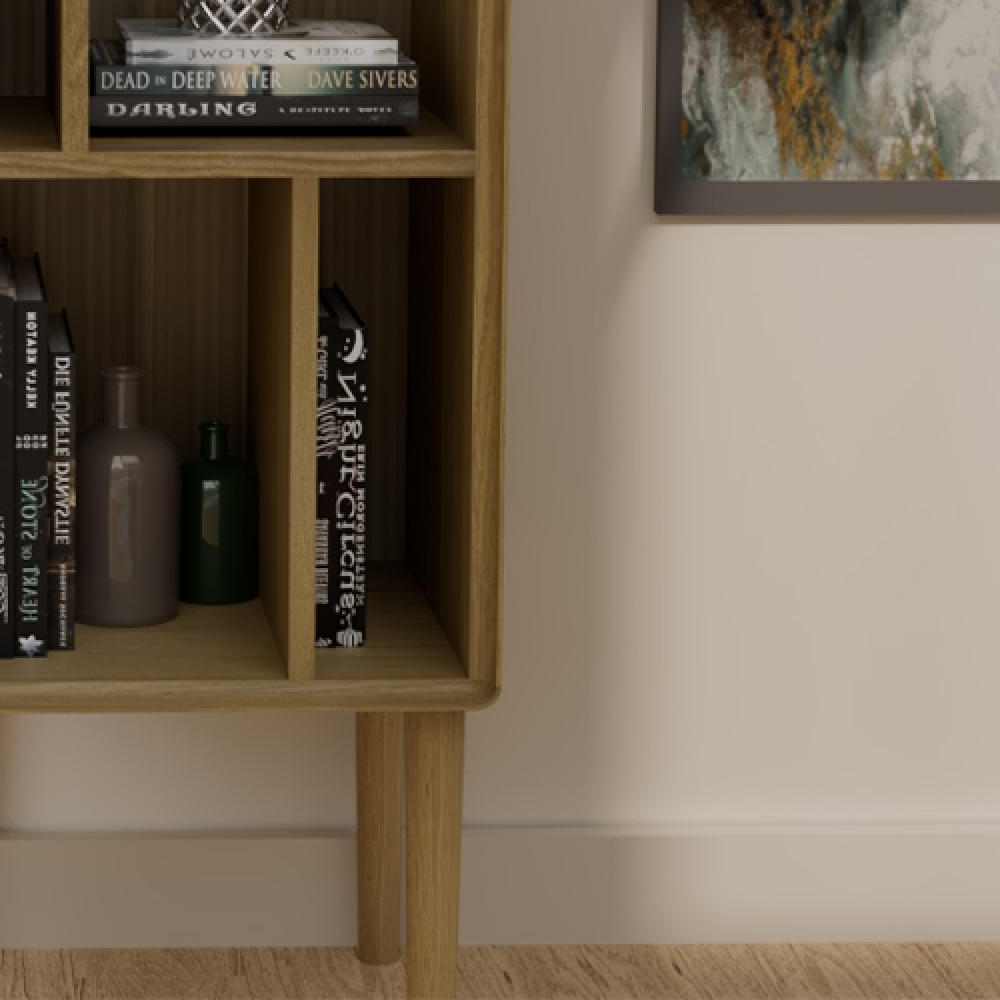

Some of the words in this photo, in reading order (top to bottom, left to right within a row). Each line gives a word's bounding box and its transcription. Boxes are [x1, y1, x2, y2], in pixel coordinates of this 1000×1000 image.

[101, 71, 150, 89] DEAD
[171, 71, 215, 89] DEEP
[219, 71, 281, 89] WATER
[308, 70, 353, 89] DAVE
[359, 70, 417, 89] SIVERS
[106, 102, 257, 118] DARLING
